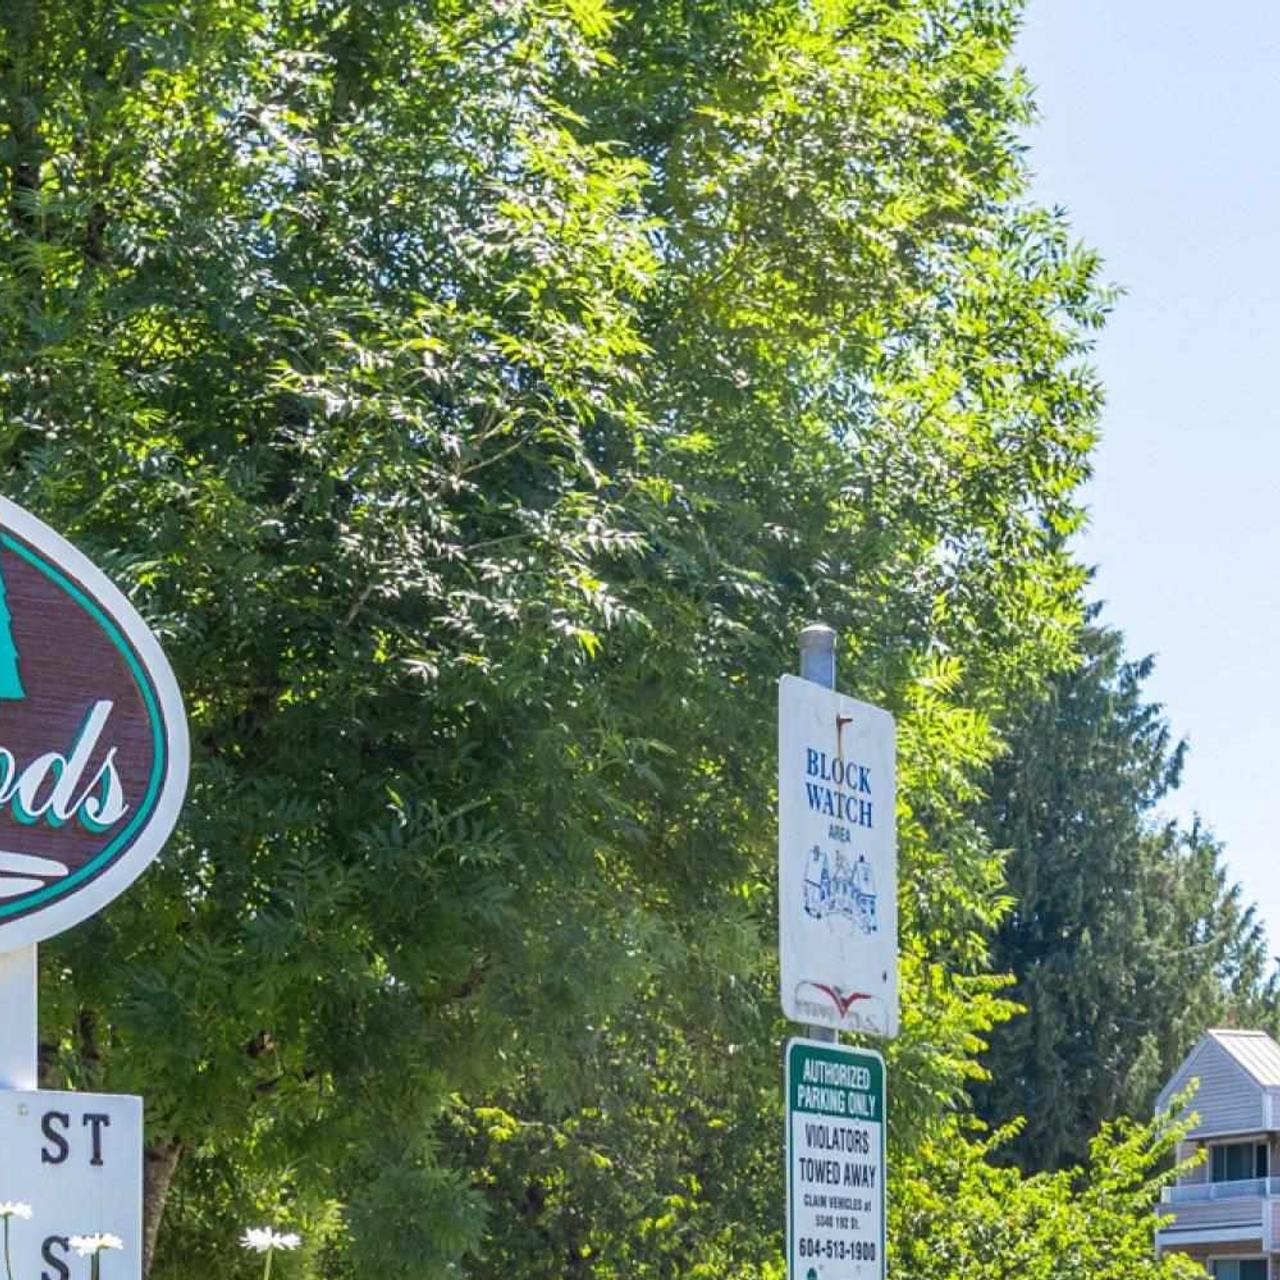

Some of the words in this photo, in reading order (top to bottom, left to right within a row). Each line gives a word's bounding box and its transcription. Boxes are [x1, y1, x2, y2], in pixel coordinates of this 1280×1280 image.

[806, 747, 871, 795] BLOCK
[805, 781, 872, 829] WATCH
[828, 823, 851, 843] AREA
[803, 1056, 871, 1091] AUTHORIZED
[797, 1084, 846, 1114] PARKING
[847, 1091, 876, 1118] ONLY
[40, 1110, 111, 1166] ST
[805, 1123, 870, 1155] VIOLATORS
[799, 1157, 841, 1185] TOWED
[842, 1162, 877, 1189] AWAY
[803, 1193, 827, 1208] CLAIM
[829, 1196, 863, 1212] VEHICLES
